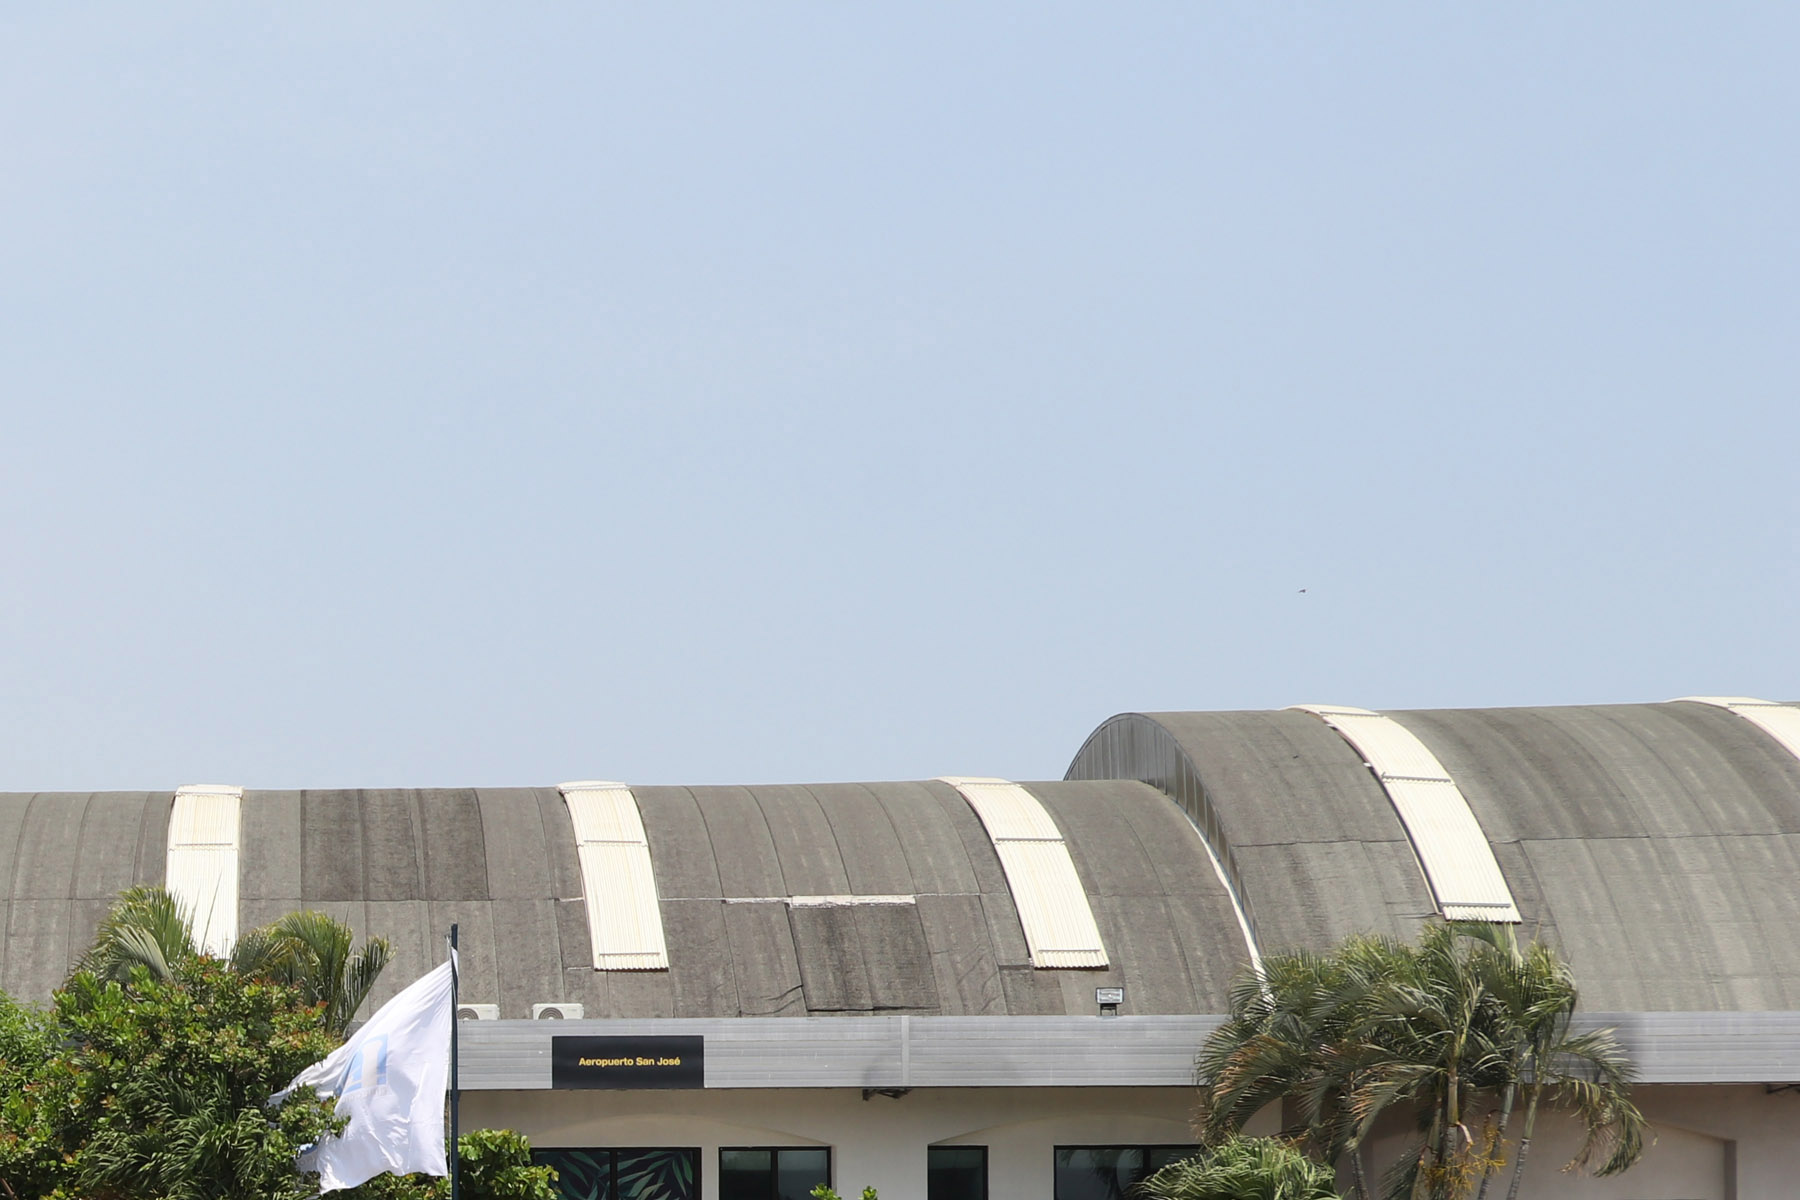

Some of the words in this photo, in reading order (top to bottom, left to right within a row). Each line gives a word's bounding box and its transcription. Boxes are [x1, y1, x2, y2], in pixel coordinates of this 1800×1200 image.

[579, 1057, 634, 1068] Aeropuerto
[636, 1057, 655, 1066] San
[657, 1056, 681, 1066] José
